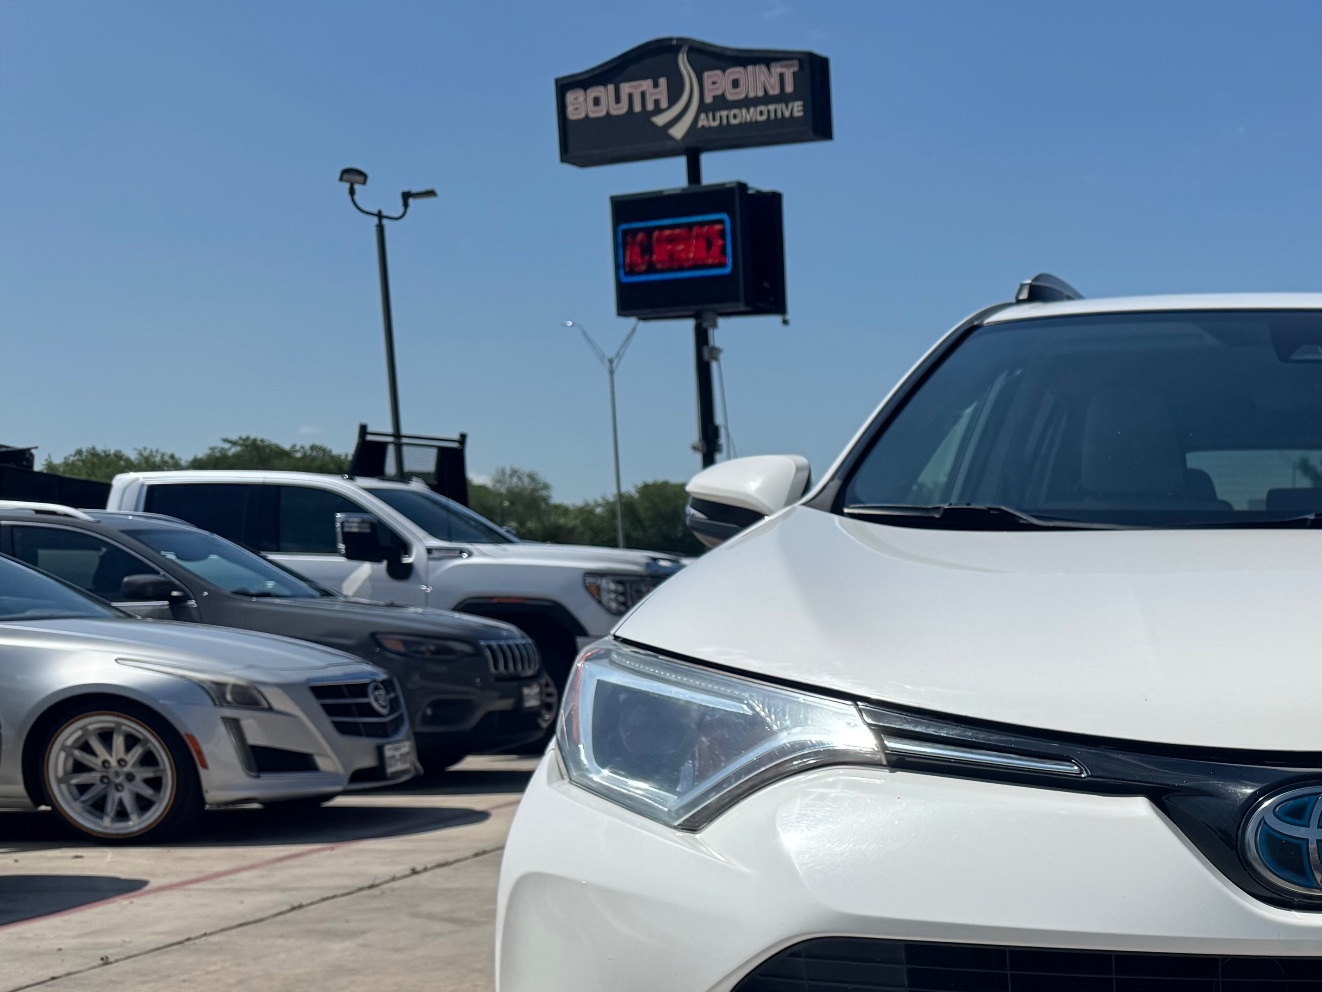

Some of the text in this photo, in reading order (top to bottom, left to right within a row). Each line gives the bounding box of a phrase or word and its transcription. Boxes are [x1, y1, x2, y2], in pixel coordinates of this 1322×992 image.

[565, 60, 800, 120] SOUTH POINT
[697, 101, 804, 128] AUTOMOTIVE
